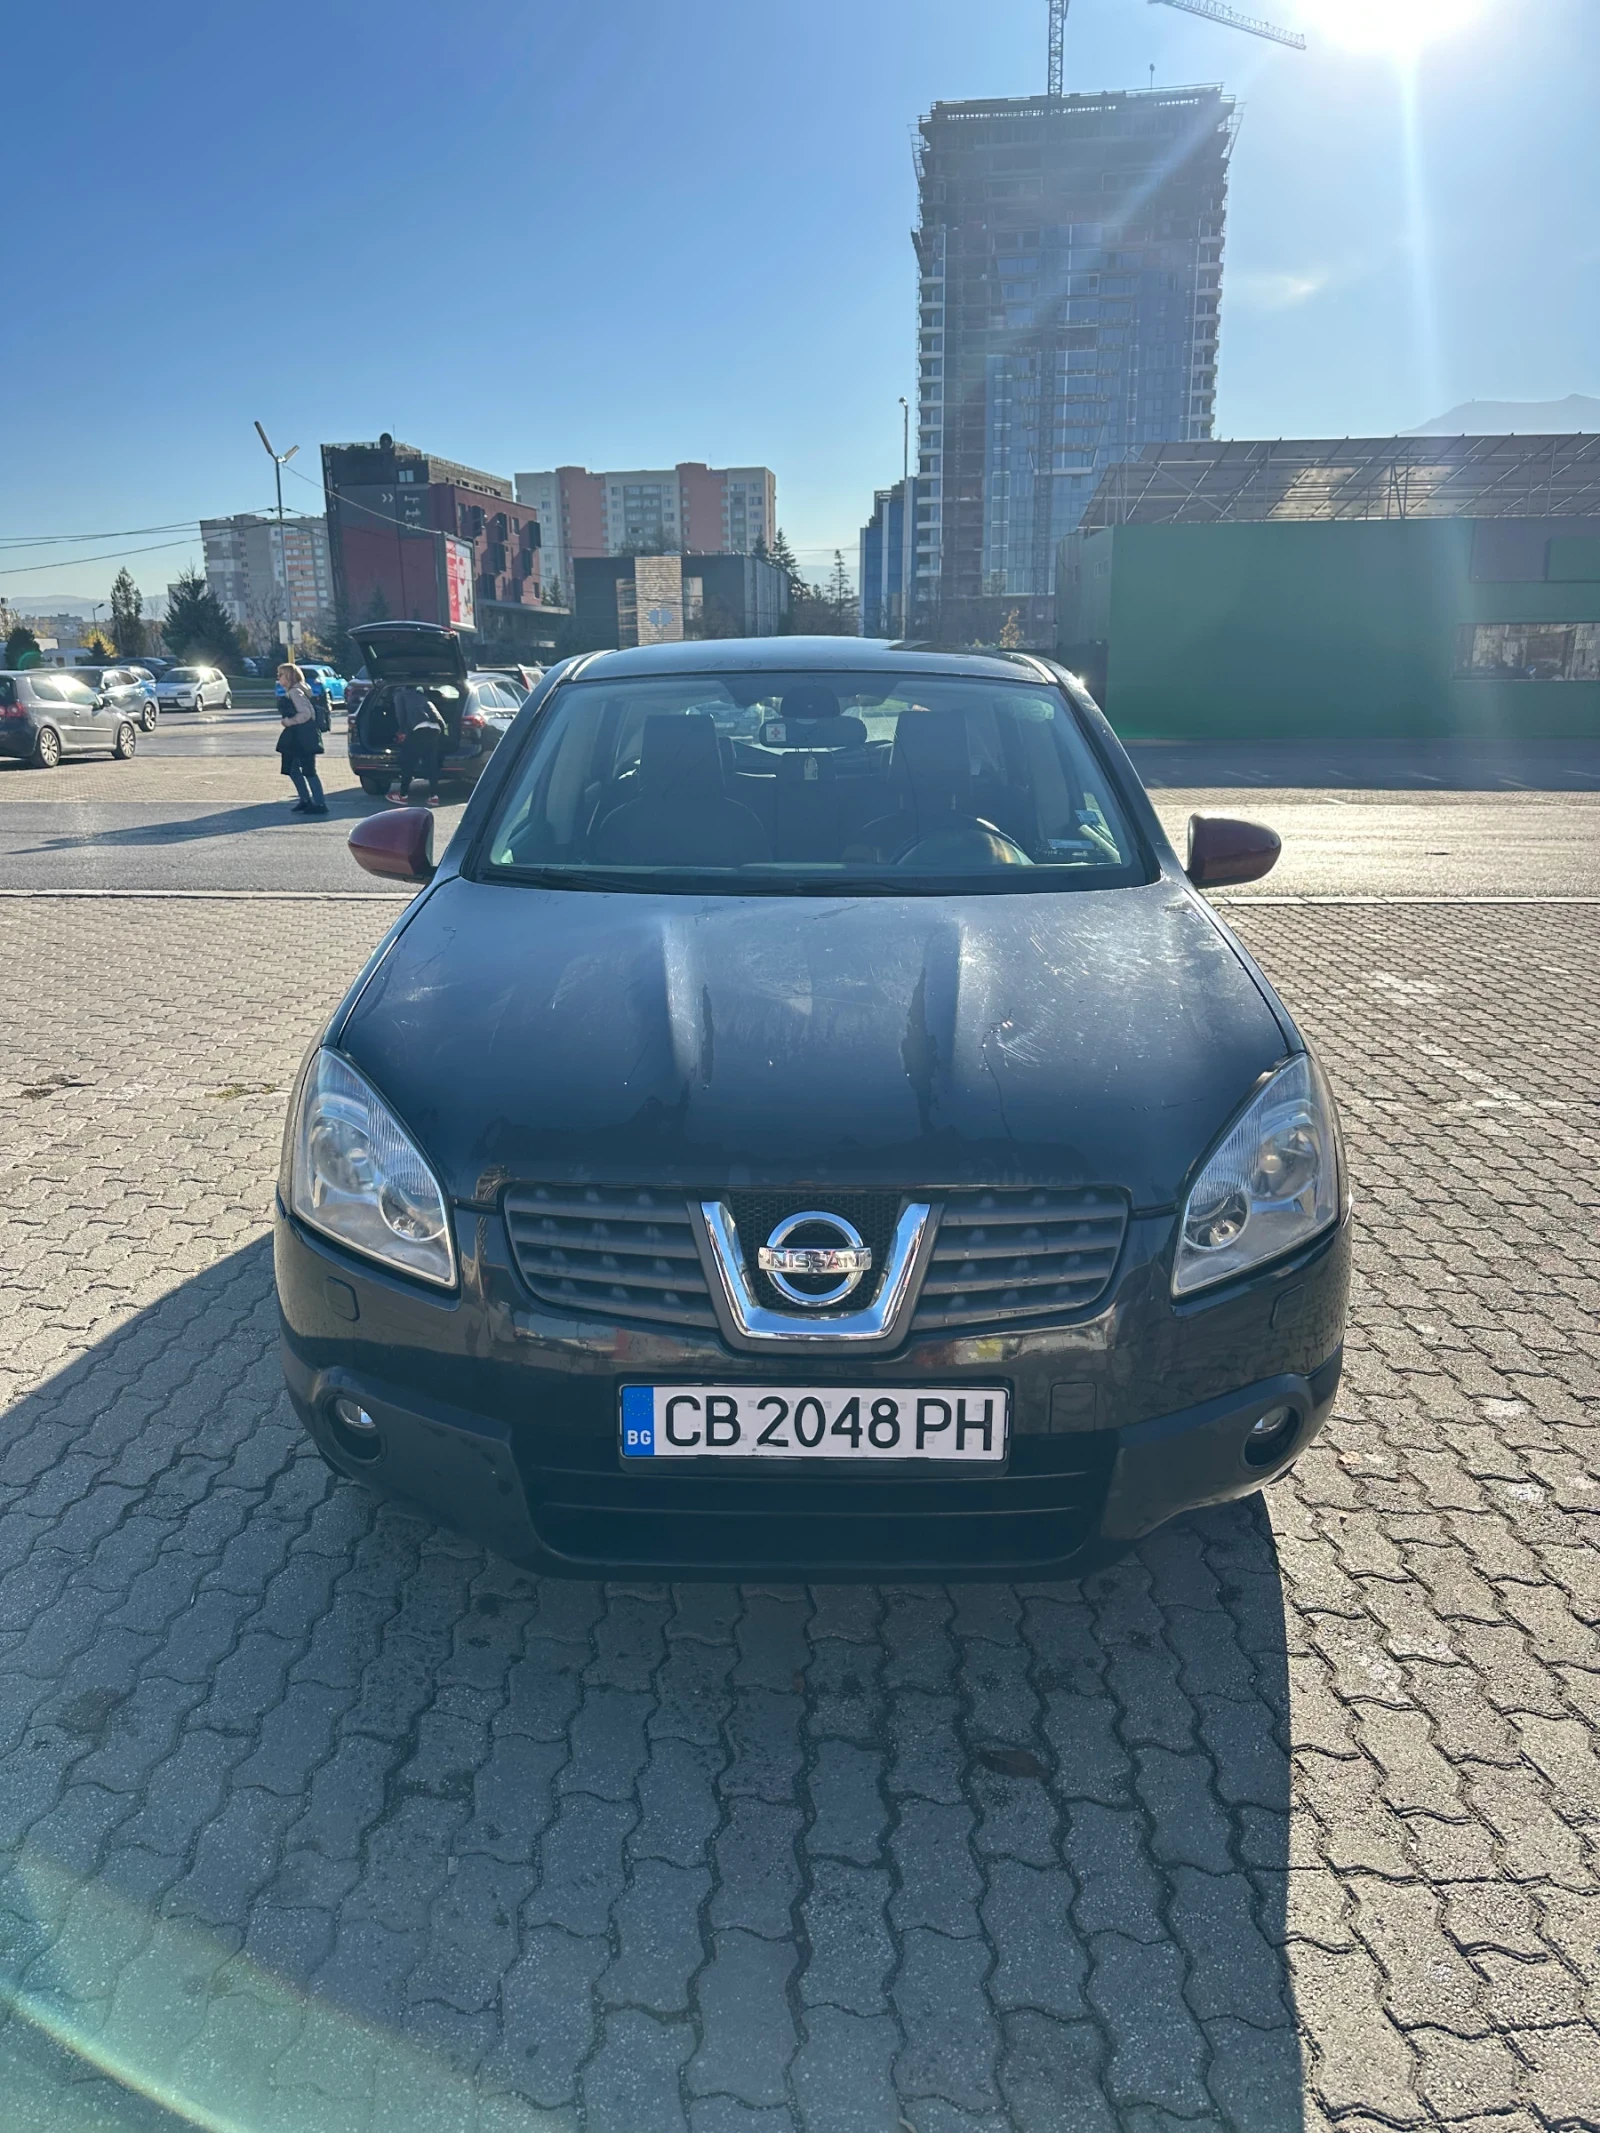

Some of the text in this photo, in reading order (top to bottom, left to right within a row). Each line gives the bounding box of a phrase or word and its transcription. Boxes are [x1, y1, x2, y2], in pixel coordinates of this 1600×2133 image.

[769, 1252, 860, 1269] NISSAN
[665, 1395, 994, 1451] CB 2048 PH
[627, 1430, 651, 1445] BG
